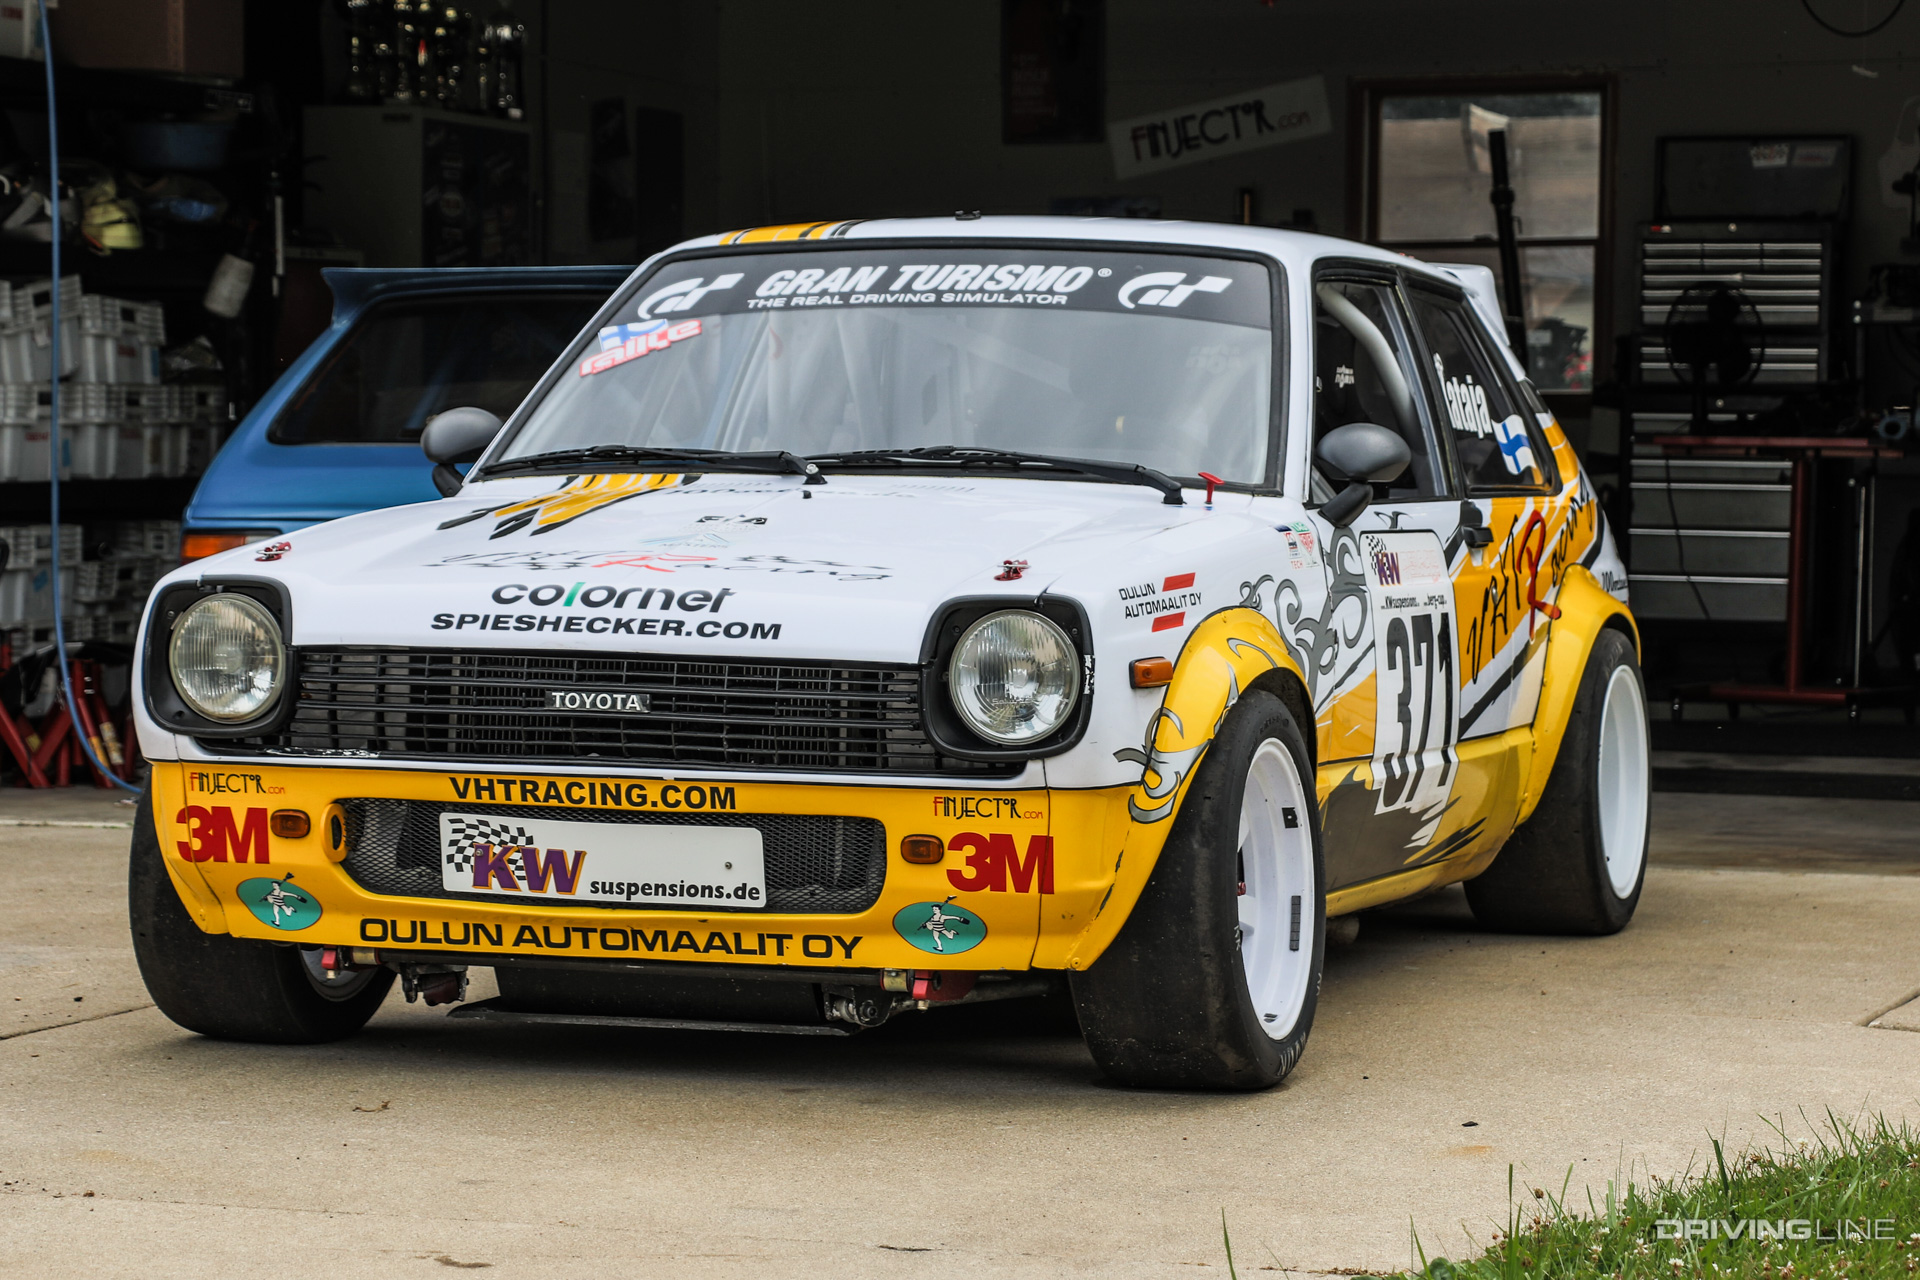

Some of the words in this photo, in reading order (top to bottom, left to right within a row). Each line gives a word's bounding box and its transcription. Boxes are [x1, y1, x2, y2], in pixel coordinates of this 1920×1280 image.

[755, 265, 889, 298] GRAN
[889, 264, 1095, 294] TURISMO
[747, 297, 787, 309] THE
[790, 295, 843, 306] REAL
[849, 292, 936, 304] DRIVING
[941, 292, 1068, 306] SIMULATOR
[1374, 551, 1402, 587] KW
[491, 582, 736, 613] colornet
[1118, 582, 1156, 601] OULUN
[1125, 594, 1188, 620] AUTOMAALIT
[1189, 592, 1203, 606] OY
[430, 613, 783, 640] SPIESHECKER.COM
[551, 691, 642, 712] TOYOTA
[1381, 611, 1452, 808] 371
[449, 776, 736, 811] VHTRACING.COM
[176, 804, 270, 865] 3M
[471, 843, 587, 897] KW
[947, 832, 1055, 896] 3M
[590, 877, 761, 908] suspensions.de
[359, 917, 503, 948] OULUN
[512, 924, 792, 957] AUTOMAALIT
[801, 934, 864, 960] OY
